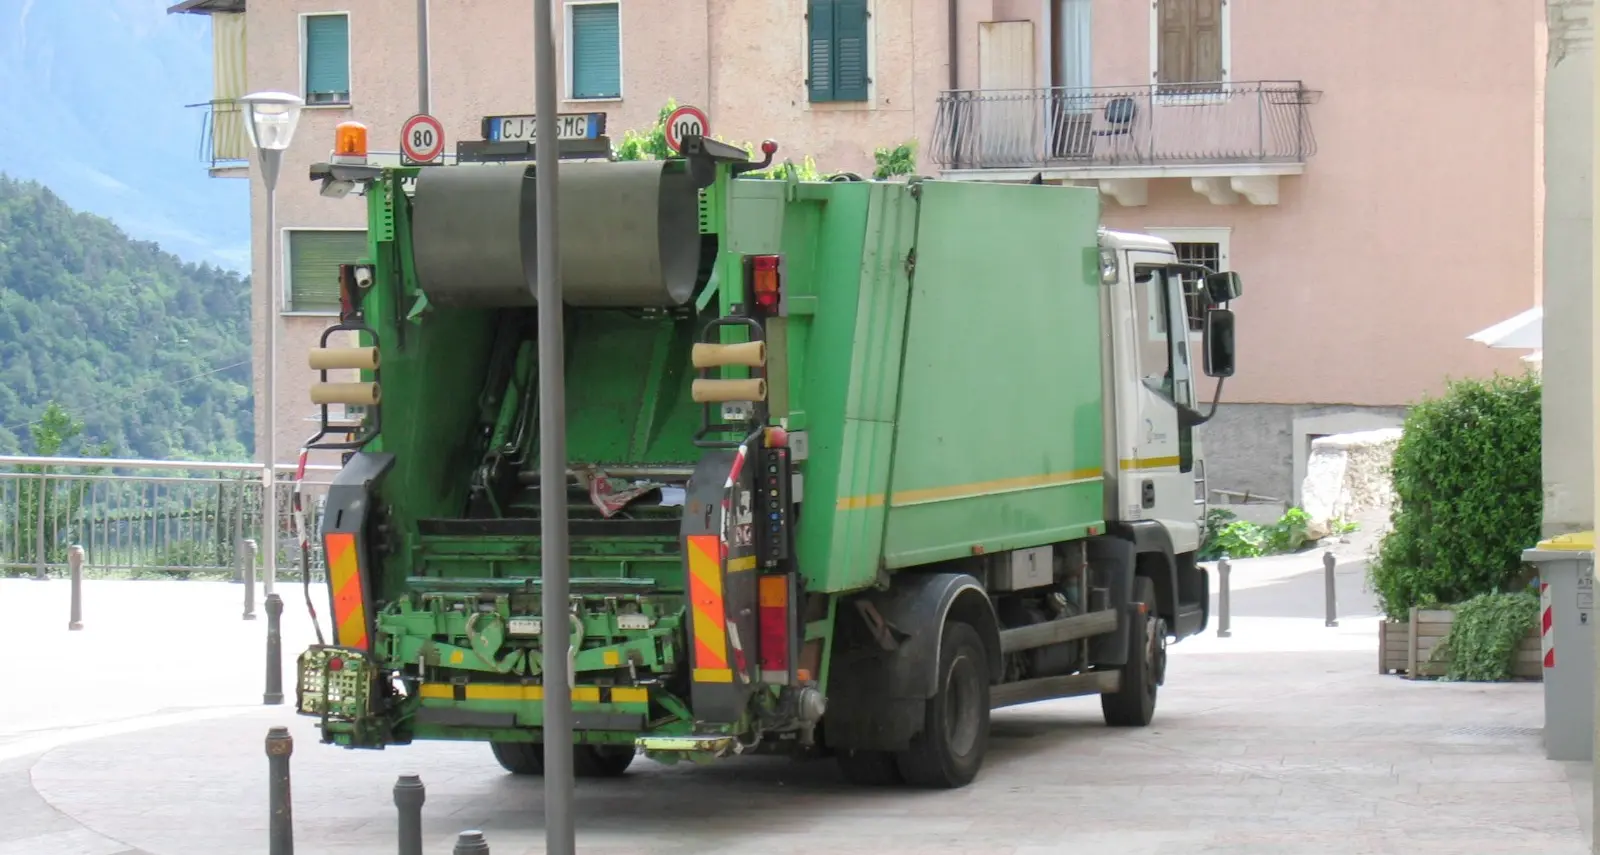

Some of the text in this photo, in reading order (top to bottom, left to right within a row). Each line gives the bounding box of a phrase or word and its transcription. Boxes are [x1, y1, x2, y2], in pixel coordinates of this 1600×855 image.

[503, 119, 523, 138] CJ
[673, 121, 700, 138] 100
[413, 129, 433, 147] 80
